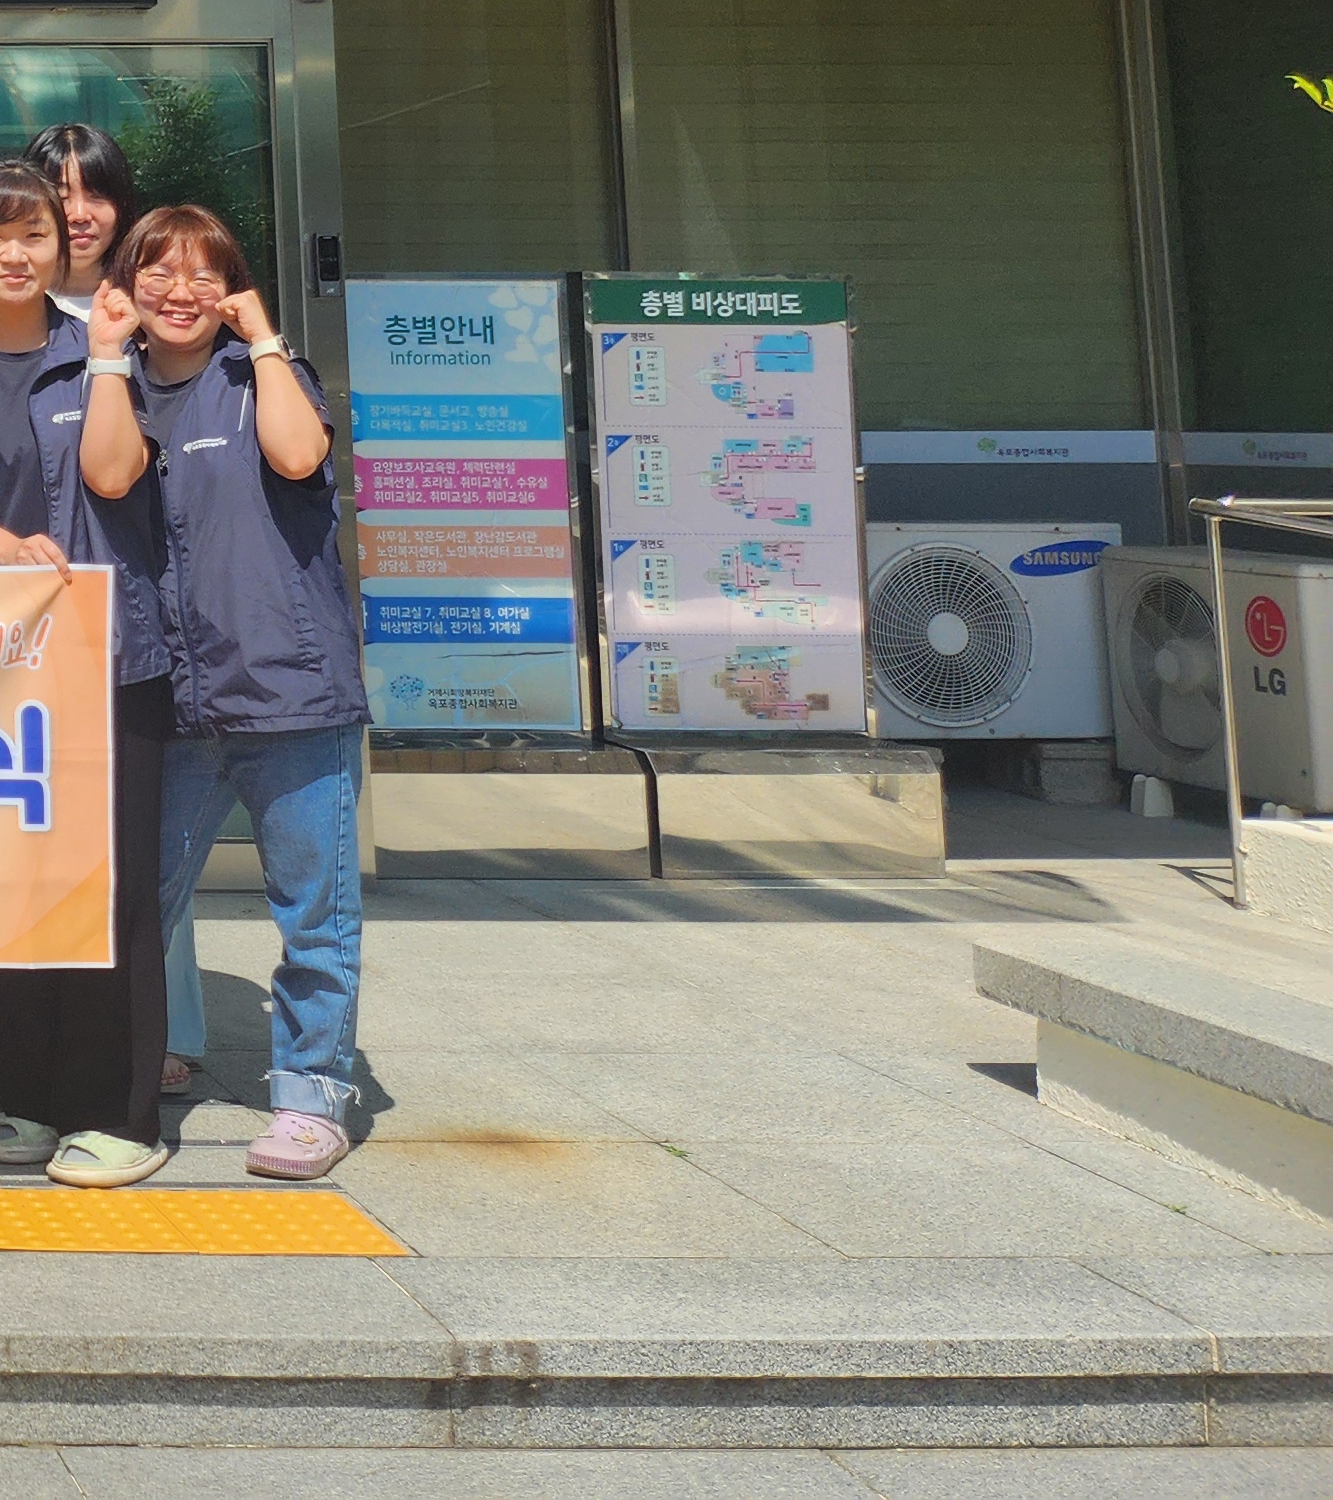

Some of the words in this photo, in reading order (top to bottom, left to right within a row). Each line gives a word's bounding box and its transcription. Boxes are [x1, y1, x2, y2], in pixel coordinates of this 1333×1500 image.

[639, 290, 685, 317] 층별
[691, 291, 803, 317] 비상대피도
[383, 315, 495, 346] 층별안내
[391, 351, 491, 365] Information
[380, 607, 421, 620] 취미교실
[438, 607, 481, 620] 취미교실
[497, 607, 531, 620] 여가실
[489, 621, 522, 635] 기계실
[1253, 666, 1286, 696] LG
[428, 698, 518, 711] 옥포종합사회복지관
